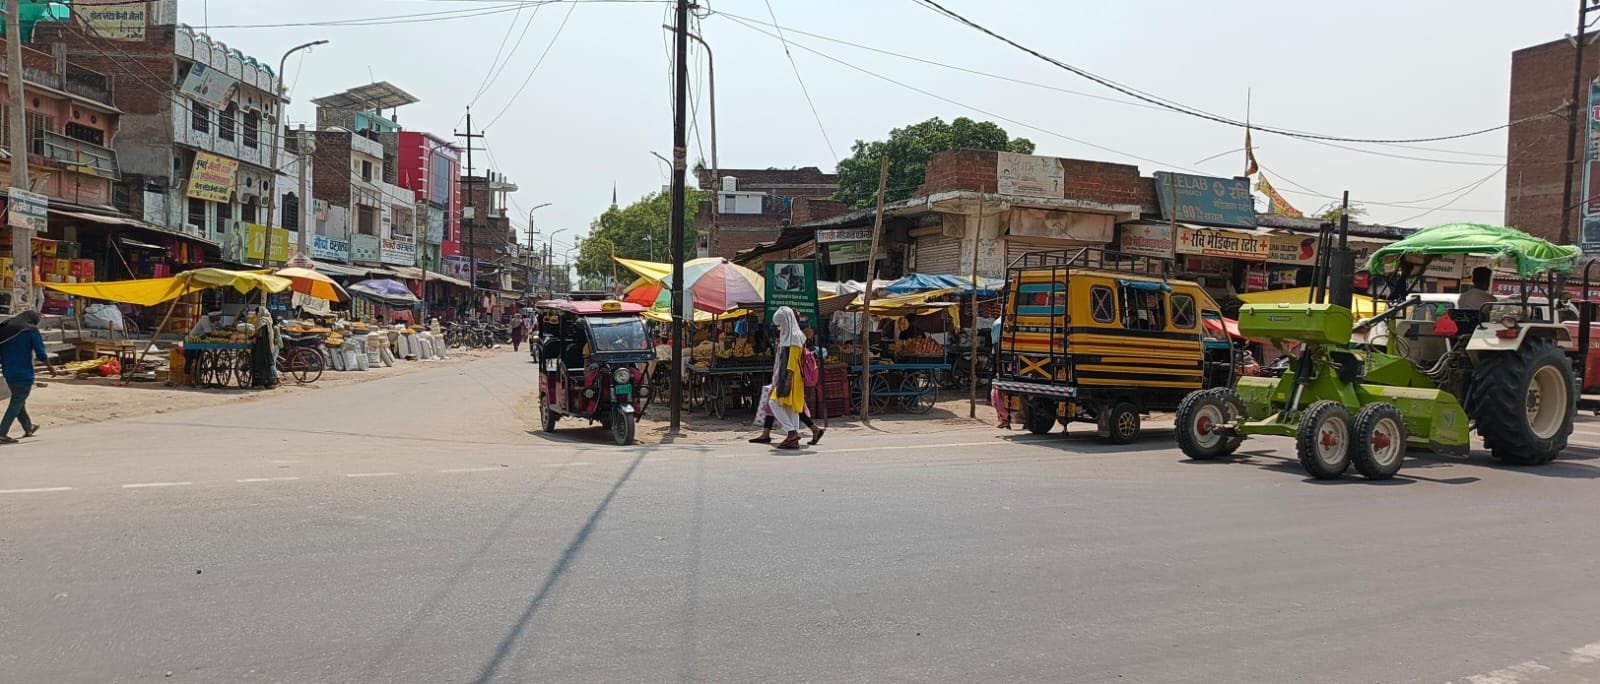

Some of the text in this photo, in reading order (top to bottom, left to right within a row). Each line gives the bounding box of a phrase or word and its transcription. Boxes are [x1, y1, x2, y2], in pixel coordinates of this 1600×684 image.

[1162, 174, 1208, 191] ZELAB
[1191, 231, 1204, 248] रवि
[1207, 232, 1240, 251] मेडिकल
[1241, 236, 1258, 253] स्टोर
